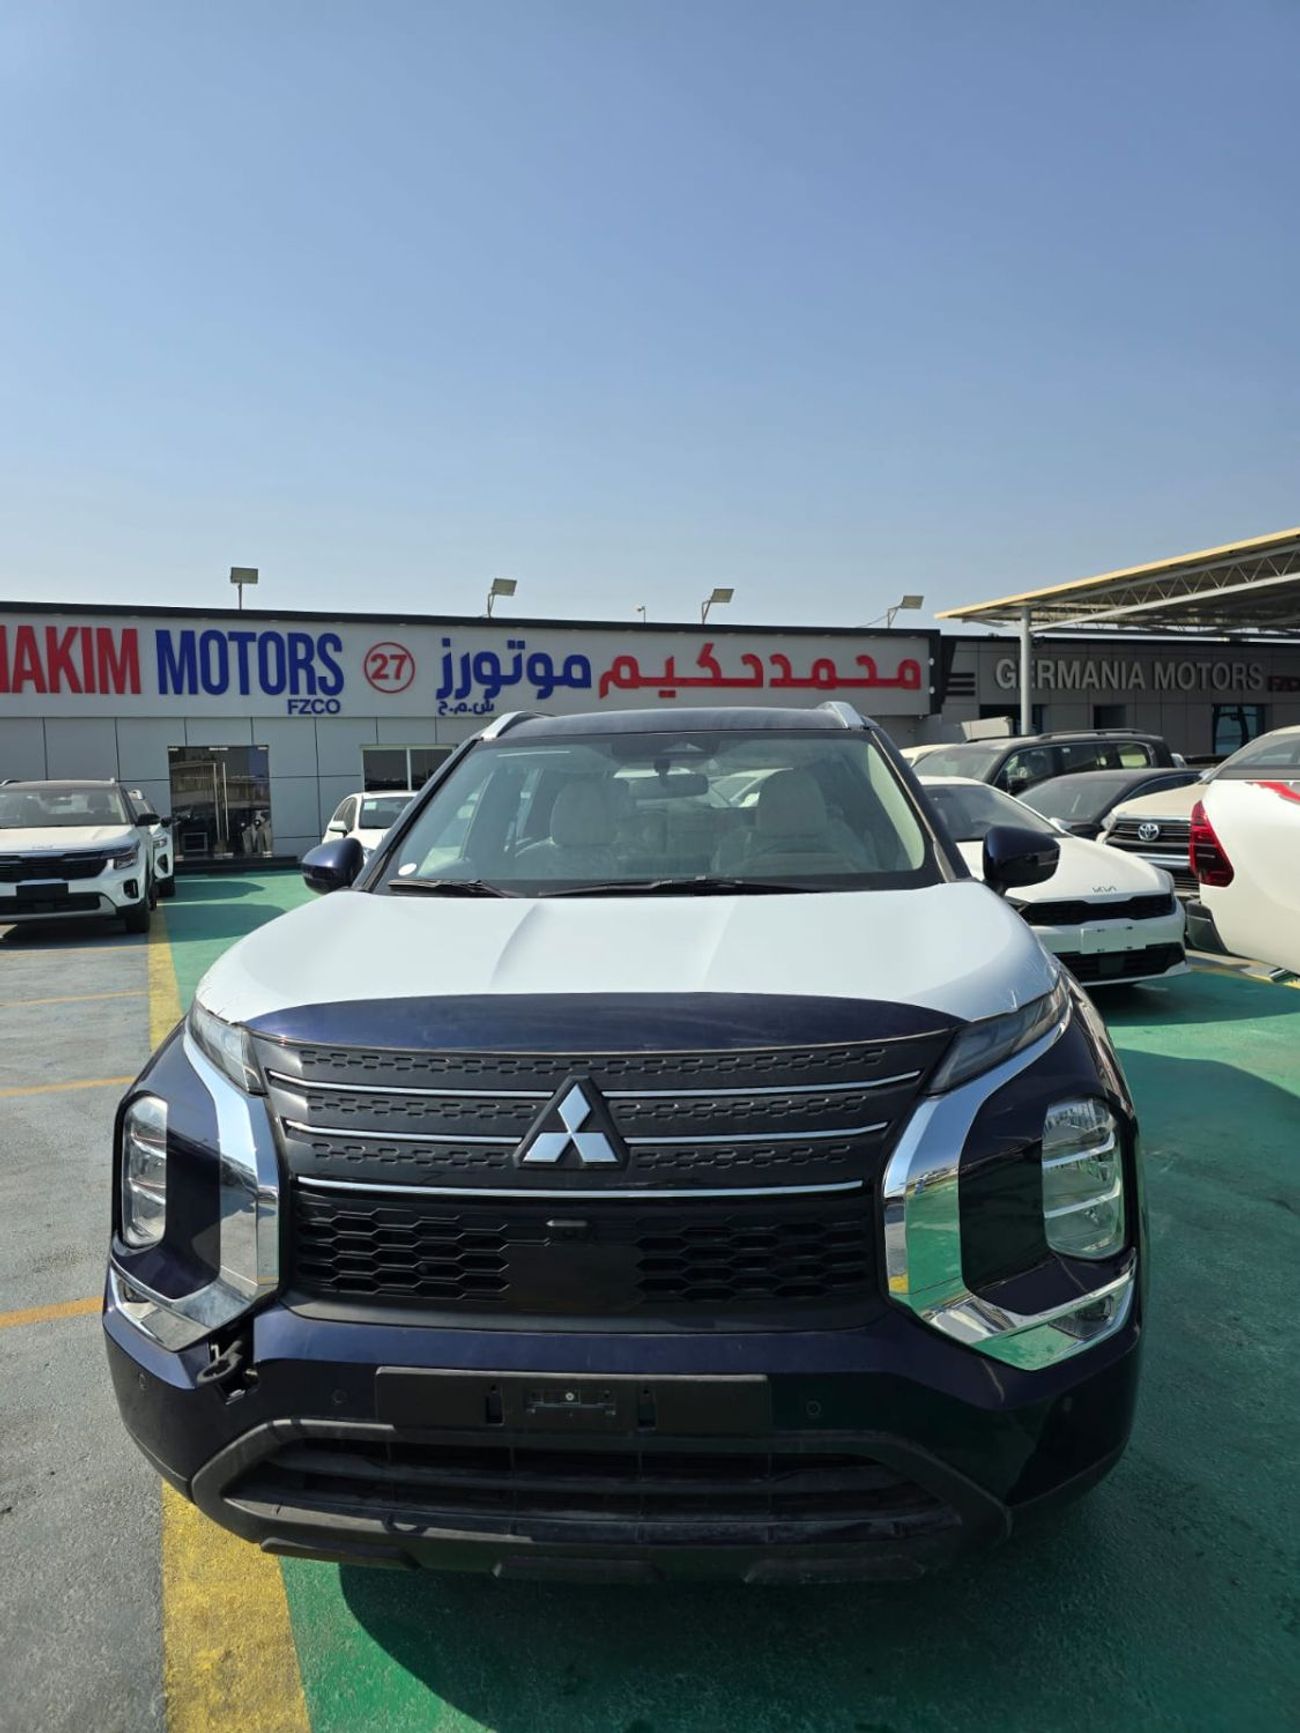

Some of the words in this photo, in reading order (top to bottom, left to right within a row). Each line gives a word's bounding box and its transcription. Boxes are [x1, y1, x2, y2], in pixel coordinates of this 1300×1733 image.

[154, 628, 345, 696] MOTORS
[370, 653, 407, 680] 27
[436, 637, 592, 700] موتورز
[599, 642, 764, 699] حكيم
[770, 653, 921, 690] محمد
[995, 658, 1146, 690] GRMANIA
[1154, 661, 1264, 691] MOTORS
[287, 699, 341, 715] FZCO
